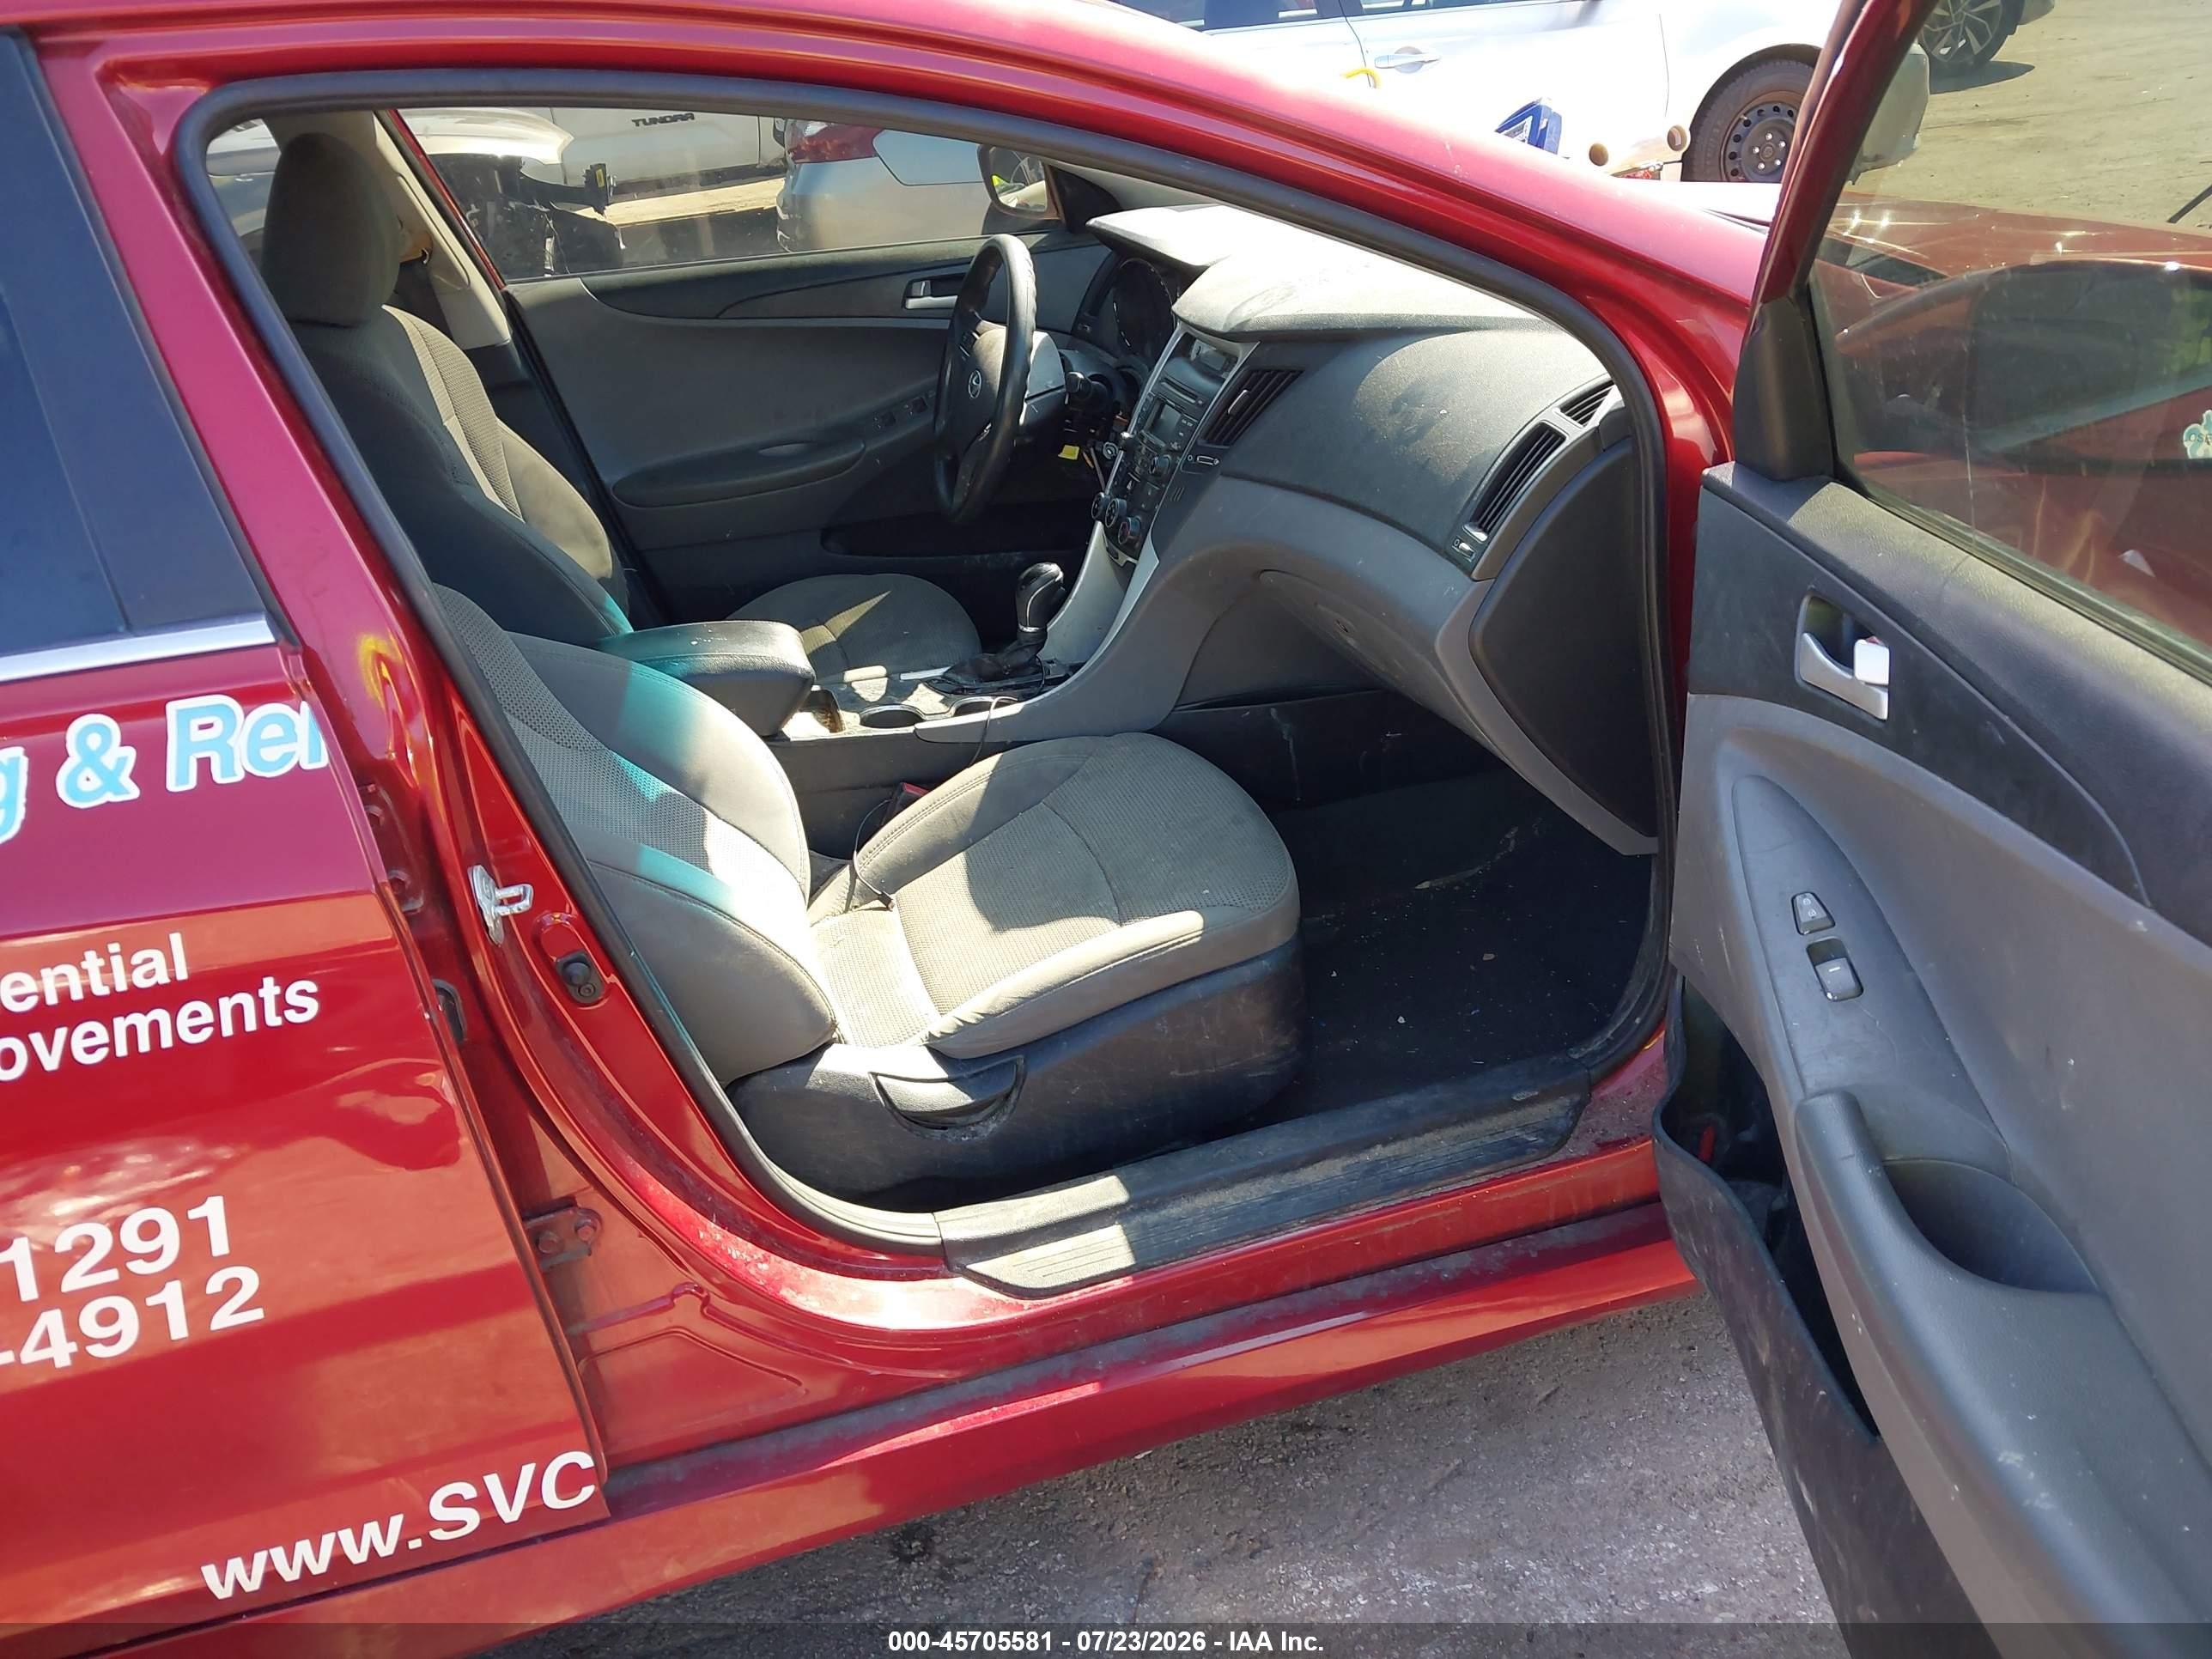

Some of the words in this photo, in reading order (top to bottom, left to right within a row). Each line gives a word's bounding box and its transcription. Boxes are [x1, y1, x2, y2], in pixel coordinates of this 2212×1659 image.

[631, 112, 695, 127] TUNDRA
[56, 714, 140, 809] &
[0, 932, 189, 1013] ential
[0, 977, 319, 1082] ovements
[0, 1195, 231, 1303] 1291
[200, 1450, 597, 1600] www.SVC
